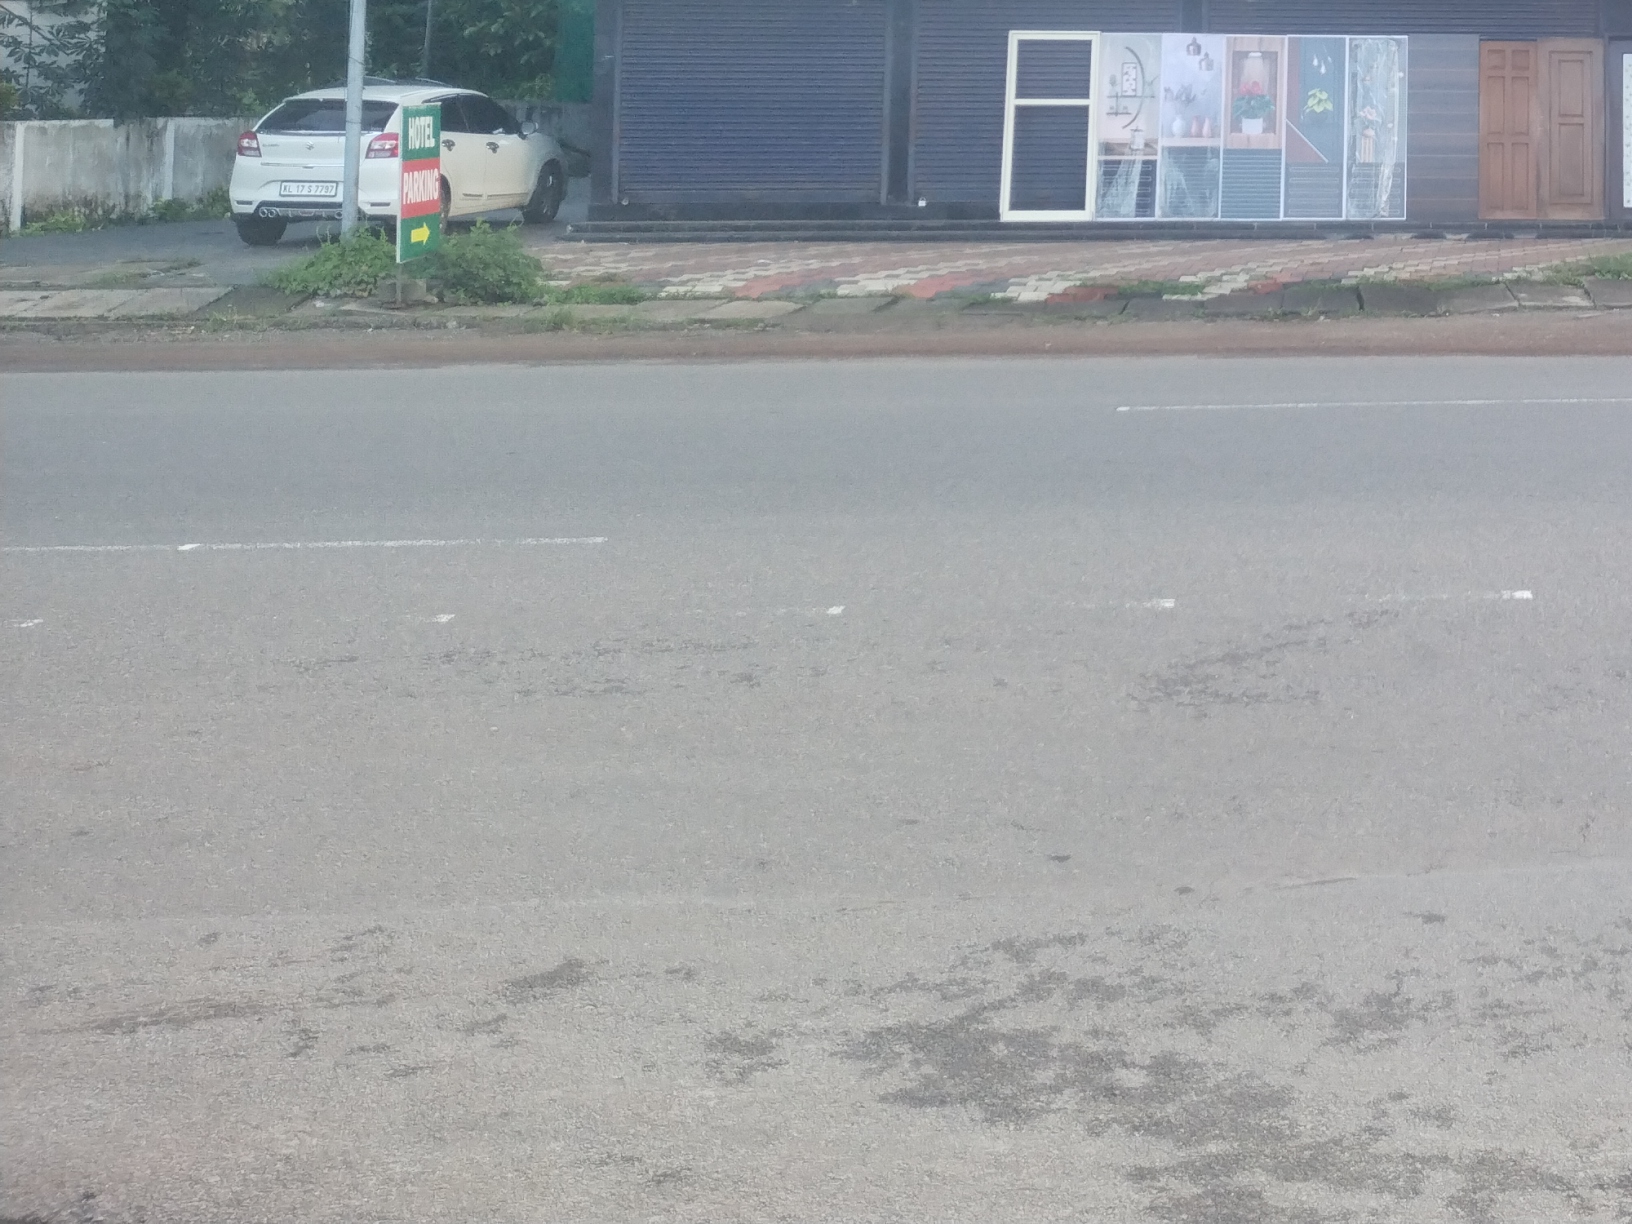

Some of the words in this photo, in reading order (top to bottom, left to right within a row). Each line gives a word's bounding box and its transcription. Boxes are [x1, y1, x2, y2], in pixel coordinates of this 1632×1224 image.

[408, 116, 436, 150] HOTEL
[297, 185, 306, 193] 17
[314, 185, 335, 194] 7797
[403, 168, 439, 205] PARKING
